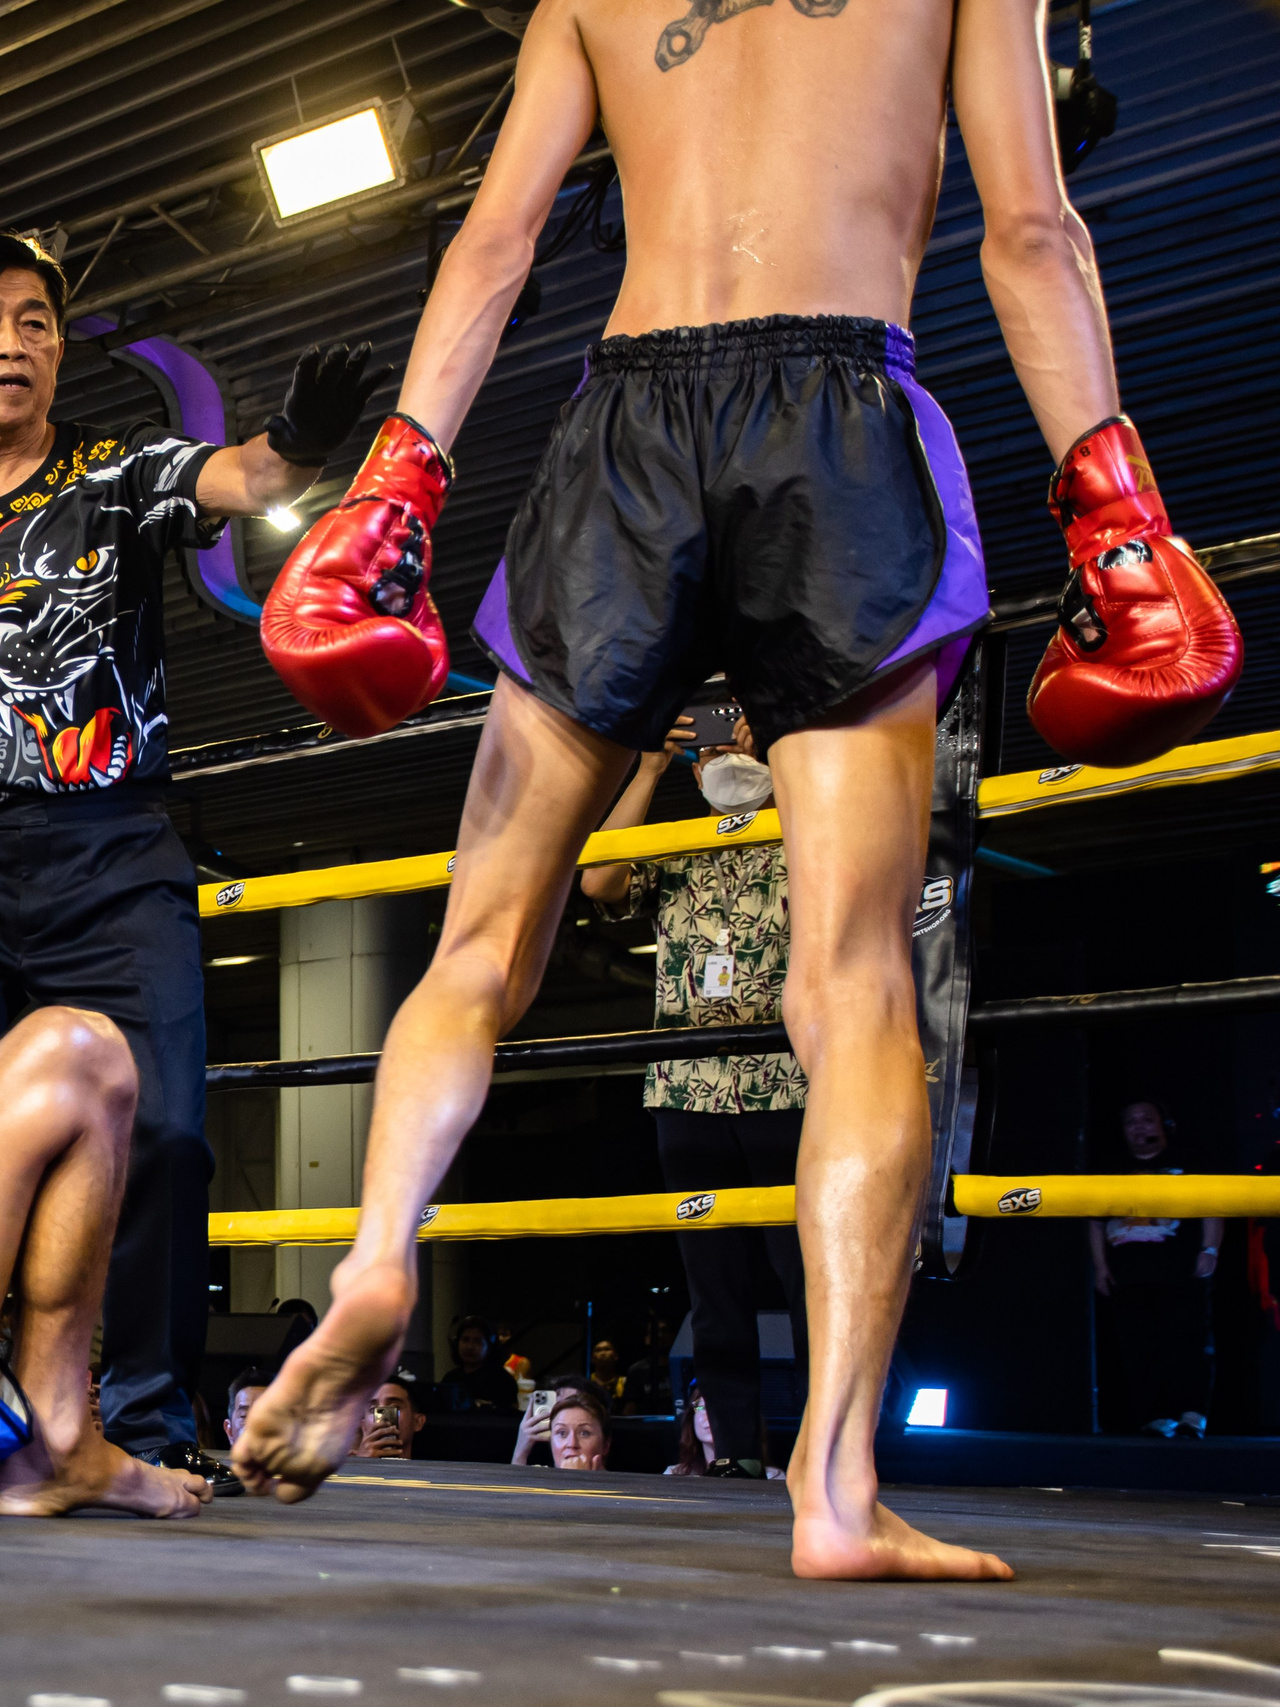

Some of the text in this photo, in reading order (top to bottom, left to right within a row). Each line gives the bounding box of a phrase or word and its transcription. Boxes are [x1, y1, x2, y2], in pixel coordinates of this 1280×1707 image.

[716, 811, 759, 835] SXS
[216, 882, 245, 906] SXS
[912, 908, 951, 938] ORTSHOP.ORG
[677, 1194, 716, 1219] SXS
[998, 1188, 1041, 1213] SXS
